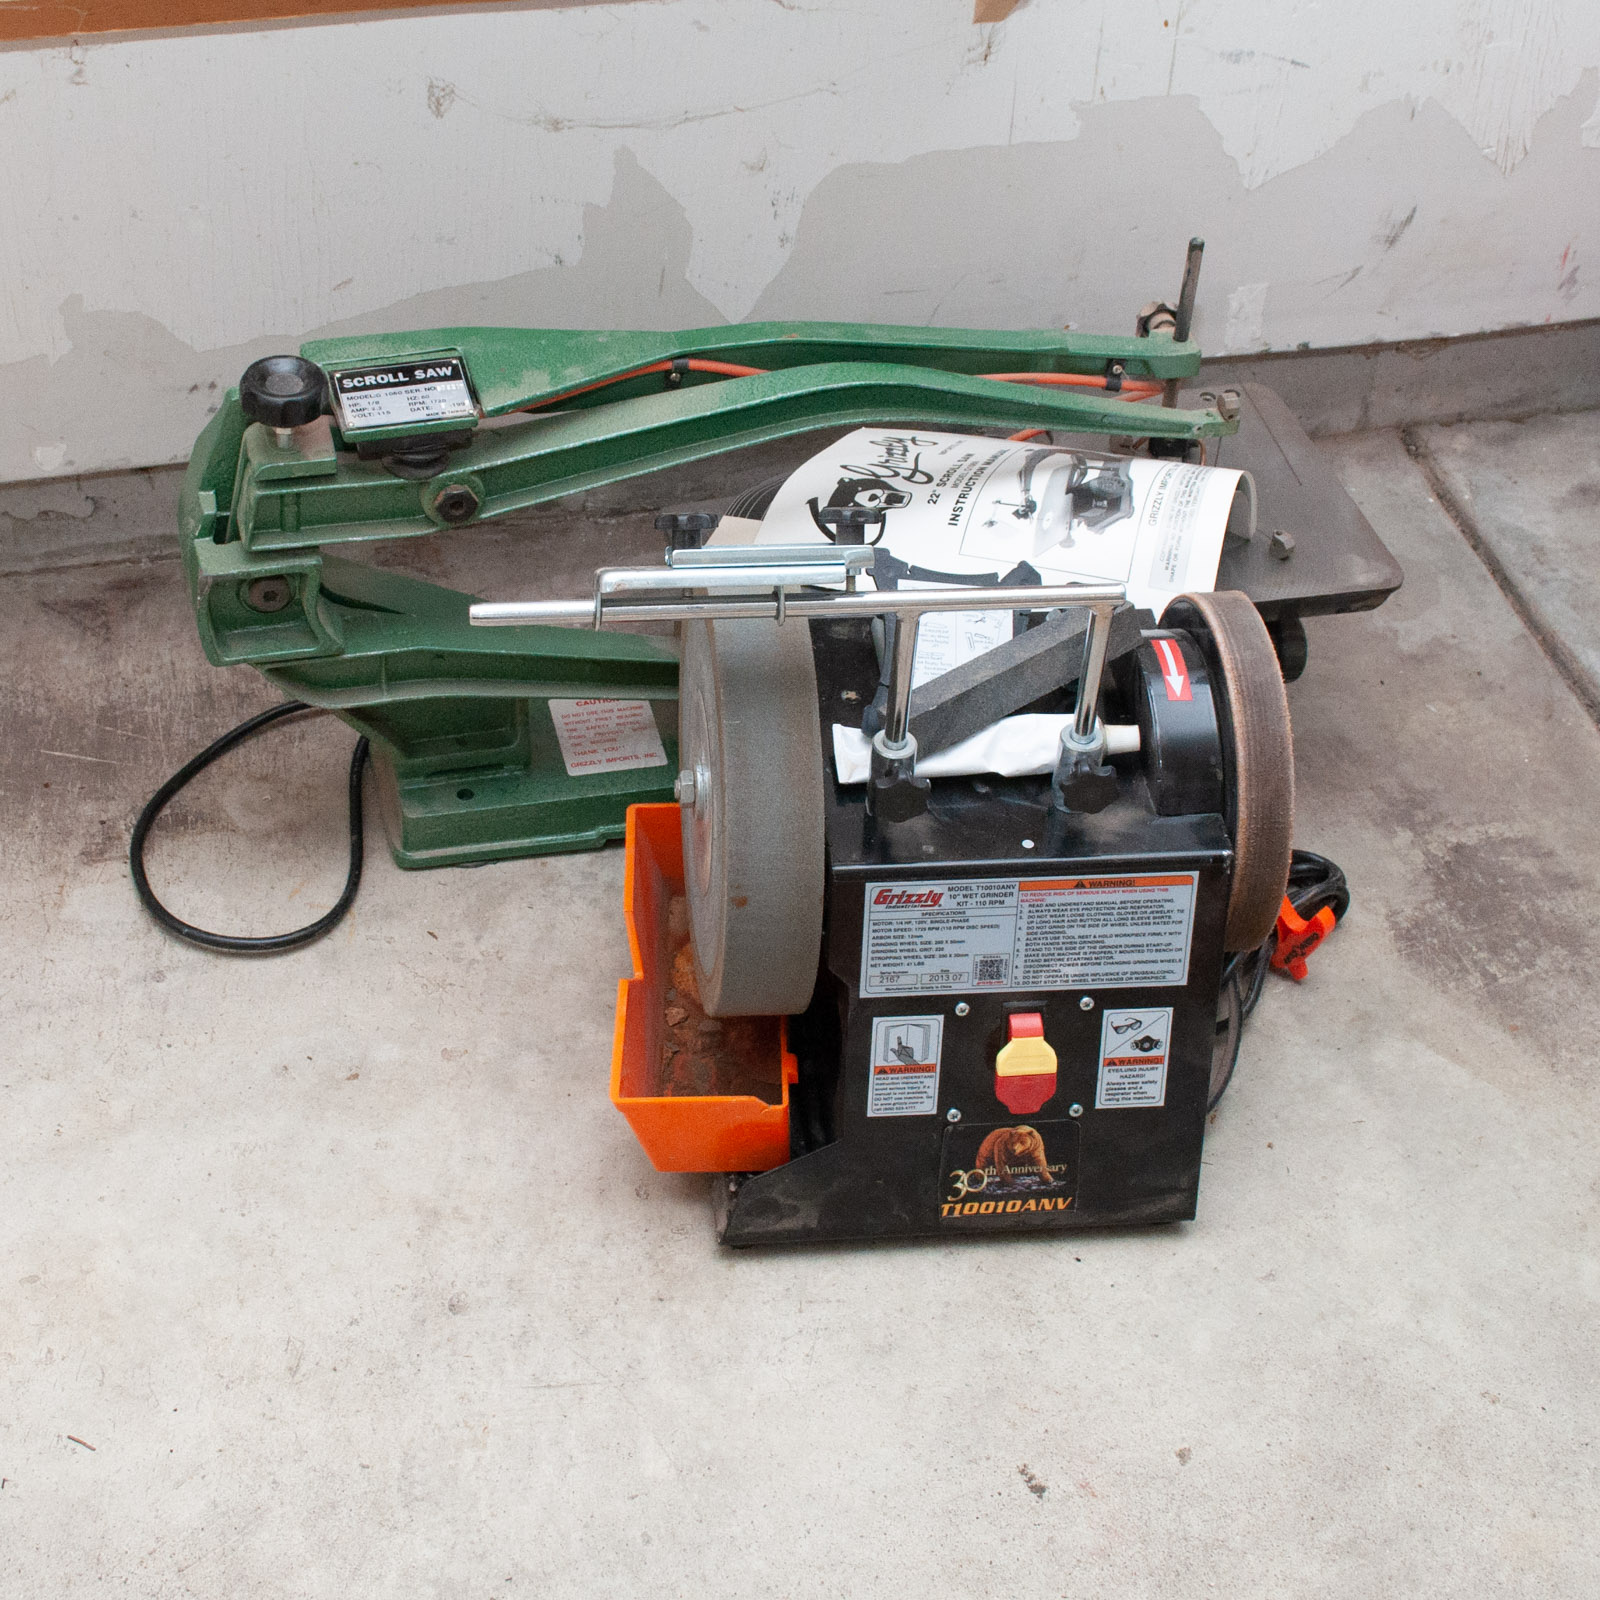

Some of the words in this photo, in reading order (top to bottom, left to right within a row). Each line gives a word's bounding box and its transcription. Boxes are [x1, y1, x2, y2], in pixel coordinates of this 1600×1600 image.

[342, 371, 409, 388] SCROLL
[414, 366, 453, 380] SAW
[936, 464, 963, 487] SCROLL
[948, 466, 989, 527] INSTRUCTION
[1148, 491, 1164, 527] GRIZZLY
[573, 749, 599, 757] THANK
[570, 759, 602, 768] GRIZZLY
[1089, 879, 1136, 888] WARNING!
[873, 888, 945, 908] Grizzly
[980, 891, 1014, 899] GRINDER
[879, 975, 900, 984] 2167
[928, 974, 950, 982] 2013
[952, 973, 963, 981] 07
[1118, 1057, 1163, 1066] WARNING!
[889, 1065, 935, 1074] WARNING!
[1001, 1163, 1068, 1175] Anniversary
[941, 1197, 1073, 1217] T10010ANV
